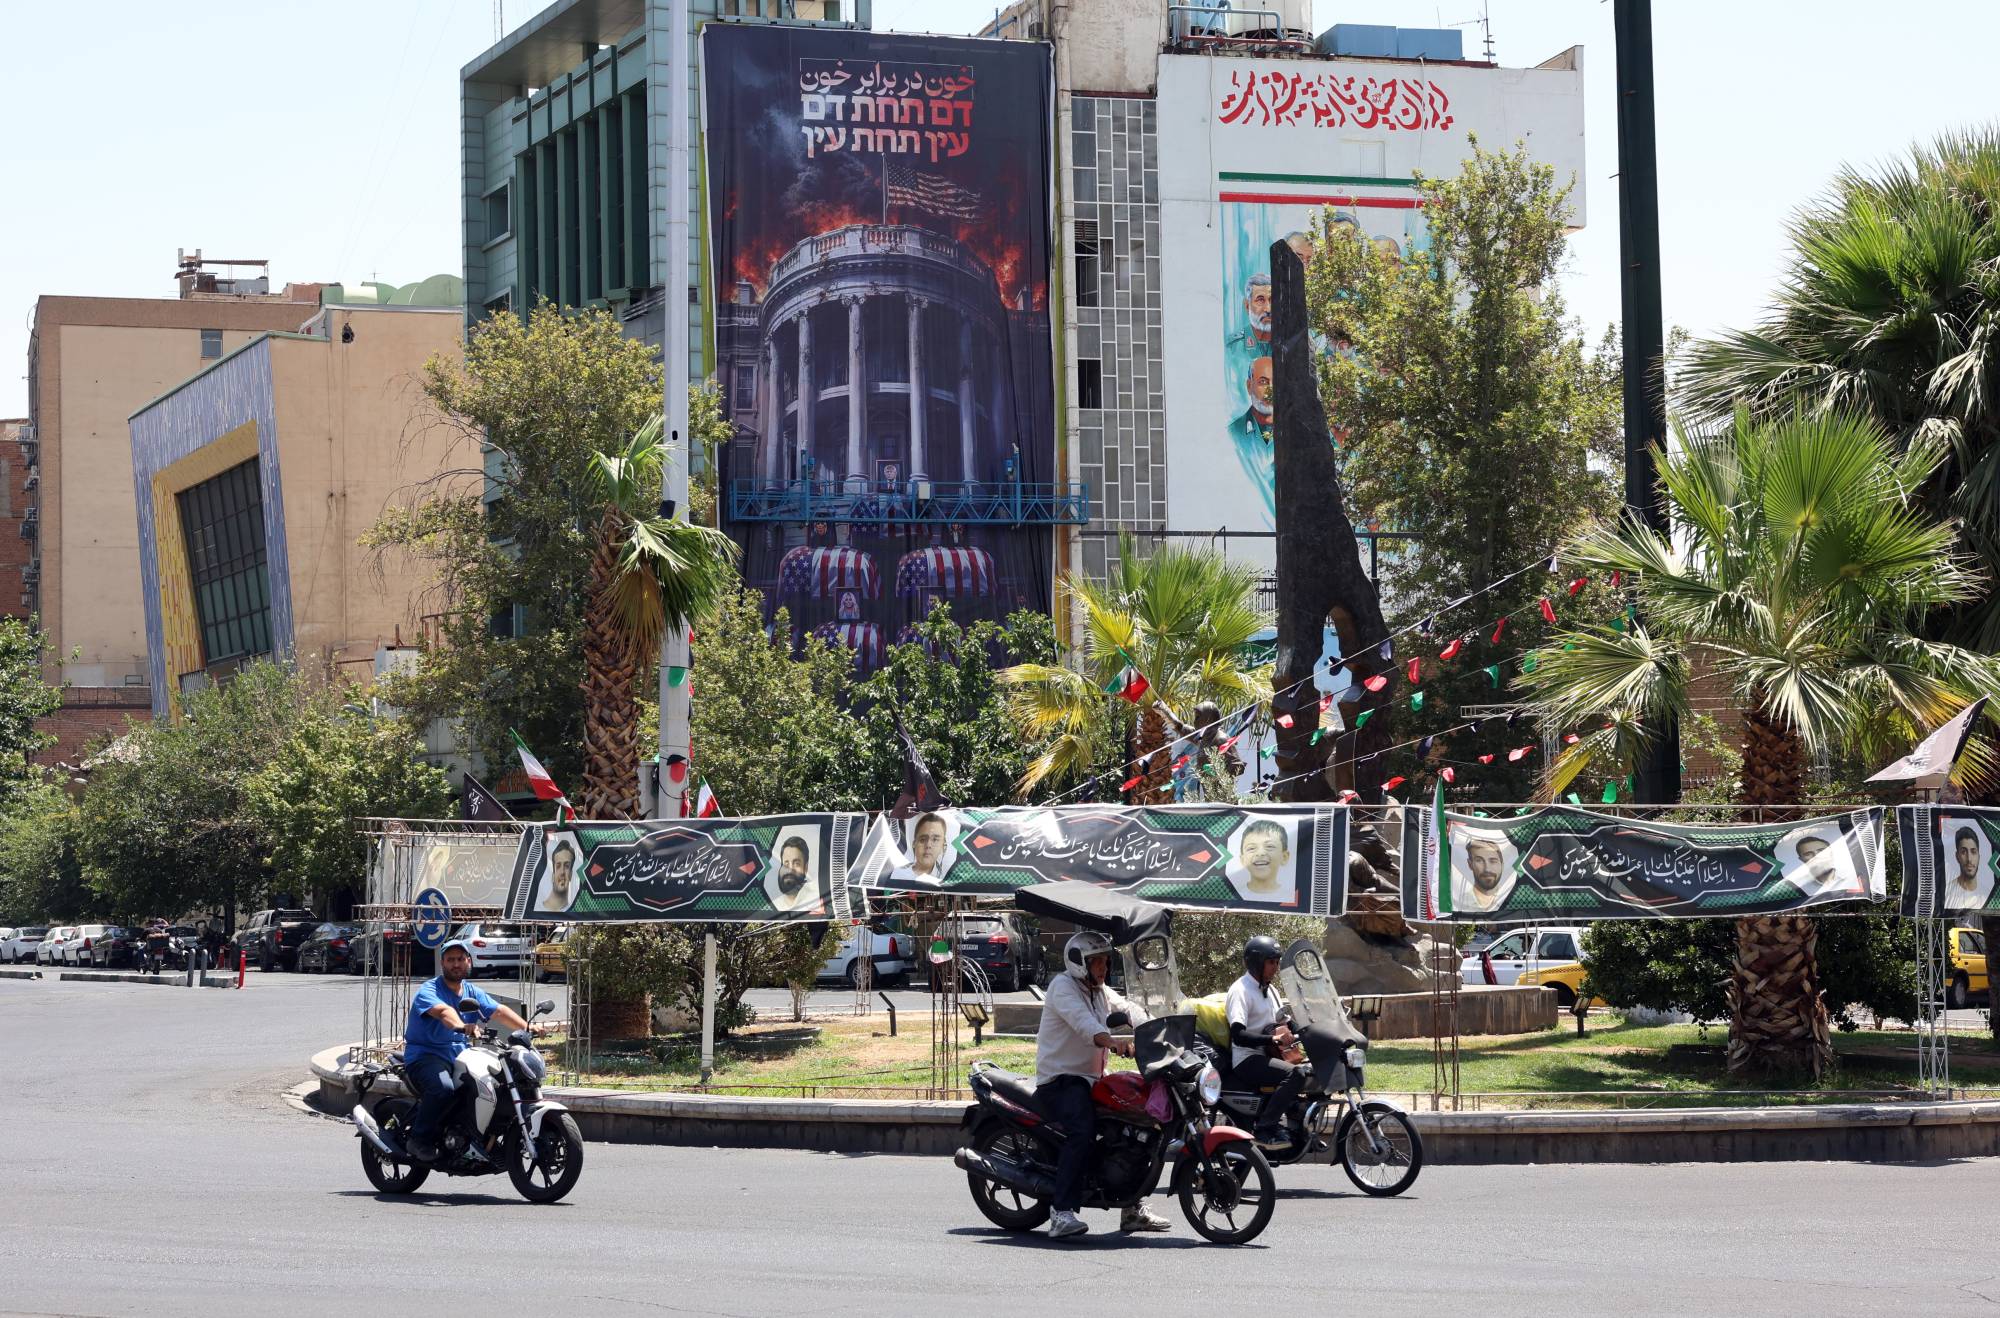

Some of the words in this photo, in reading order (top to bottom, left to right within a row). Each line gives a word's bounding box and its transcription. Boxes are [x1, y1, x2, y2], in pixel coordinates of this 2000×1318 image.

[799, 60, 852, 94] خون
[852, 60, 897, 97] برابر
[897, 70, 923, 97] در
[924, 65, 976, 100] خون
[800, 93, 847, 121] דם
[850, 95, 925, 125] תחת
[929, 98, 974, 127] דם
[800, 125, 847, 159] עין
[850, 127, 922, 154] תחת
[924, 130, 970, 163] עין
